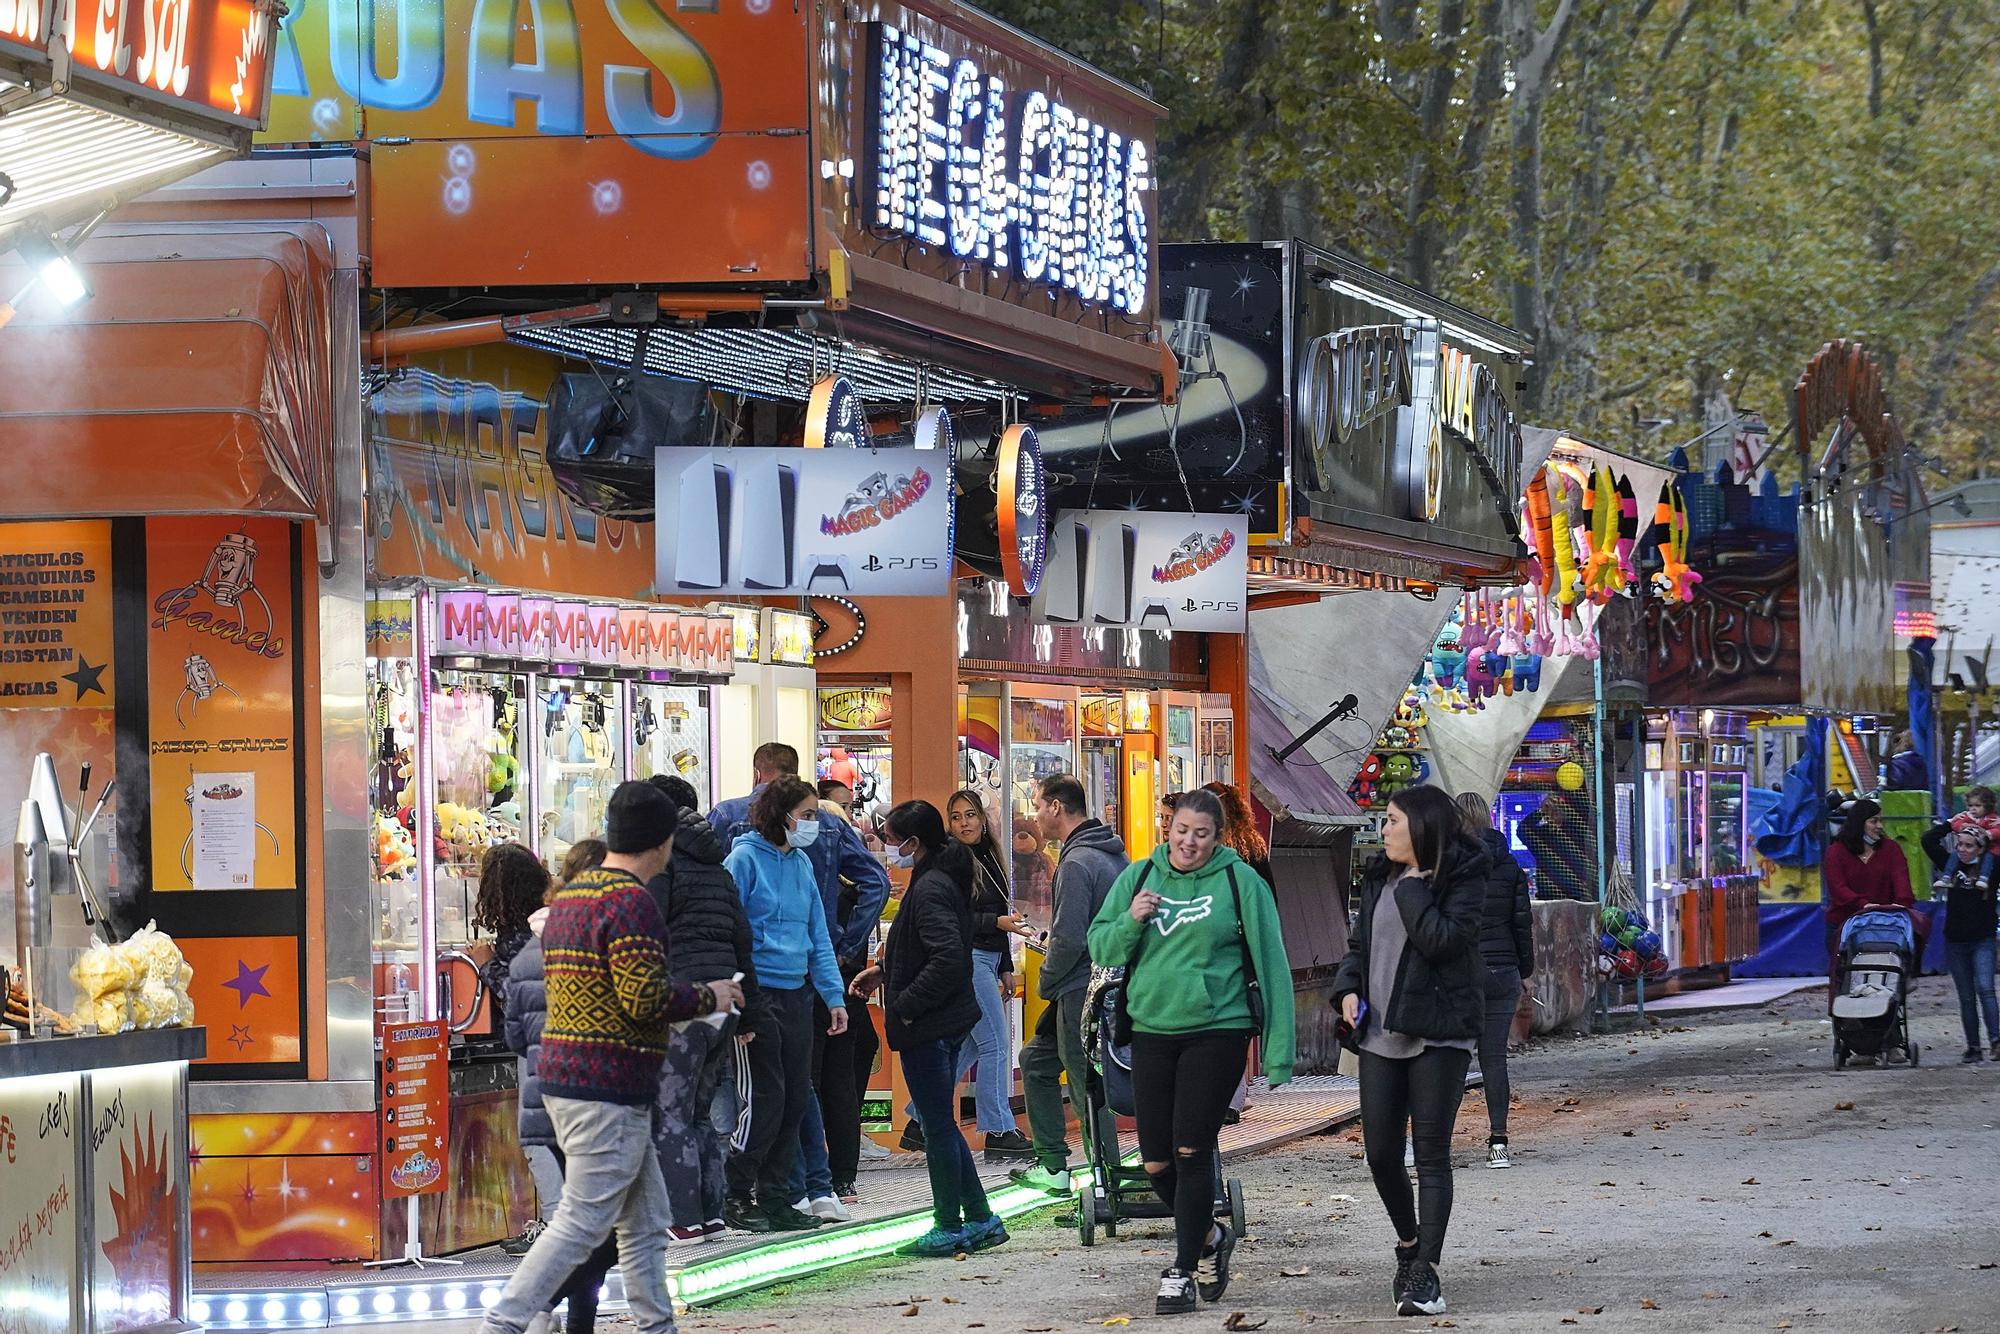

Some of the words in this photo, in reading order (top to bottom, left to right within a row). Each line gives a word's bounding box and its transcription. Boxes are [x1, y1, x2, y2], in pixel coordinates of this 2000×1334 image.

[1302, 325, 1417, 493] QUEEN
[820, 505, 881, 538] MAGIC
[878, 466, 932, 521] GAMES
[0, 552, 84, 567] TICULOS
[1151, 558, 1198, 584] MAGIC
[1195, 527, 1236, 571] GAMES
[888, 557, 938, 570] PS5
[1201, 600, 1239, 612] PS5
[2, 610, 77, 624] VENDEN
[3, 629, 63, 644] FAVOR
[0, 648, 73, 663] SISTAN
[151, 737, 289, 755] MEGA-GRUAS
[392, 1026, 440, 1042] ENTRADA
